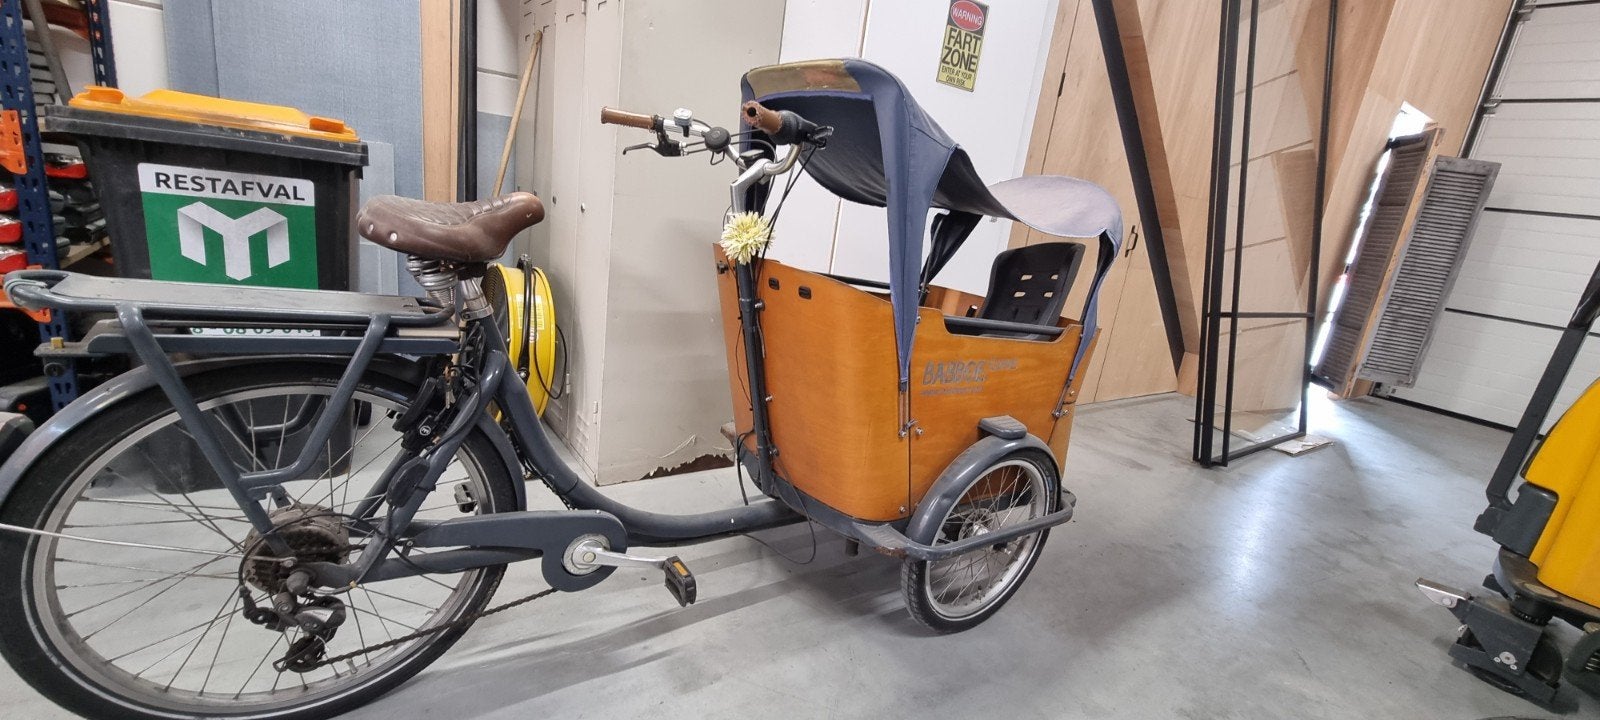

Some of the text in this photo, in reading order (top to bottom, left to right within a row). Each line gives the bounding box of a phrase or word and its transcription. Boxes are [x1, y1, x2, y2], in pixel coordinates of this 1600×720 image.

[952, 7, 983, 26] WARNING
[947, 27, 982, 54] FART
[941, 45, 978, 73] ZONE
[941, 65, 955, 75] ENTER
[961, 71, 973, 81] YOUR
[946, 74, 966, 86] OWN RISK
[154, 171, 306, 202] RESTAFVAL
